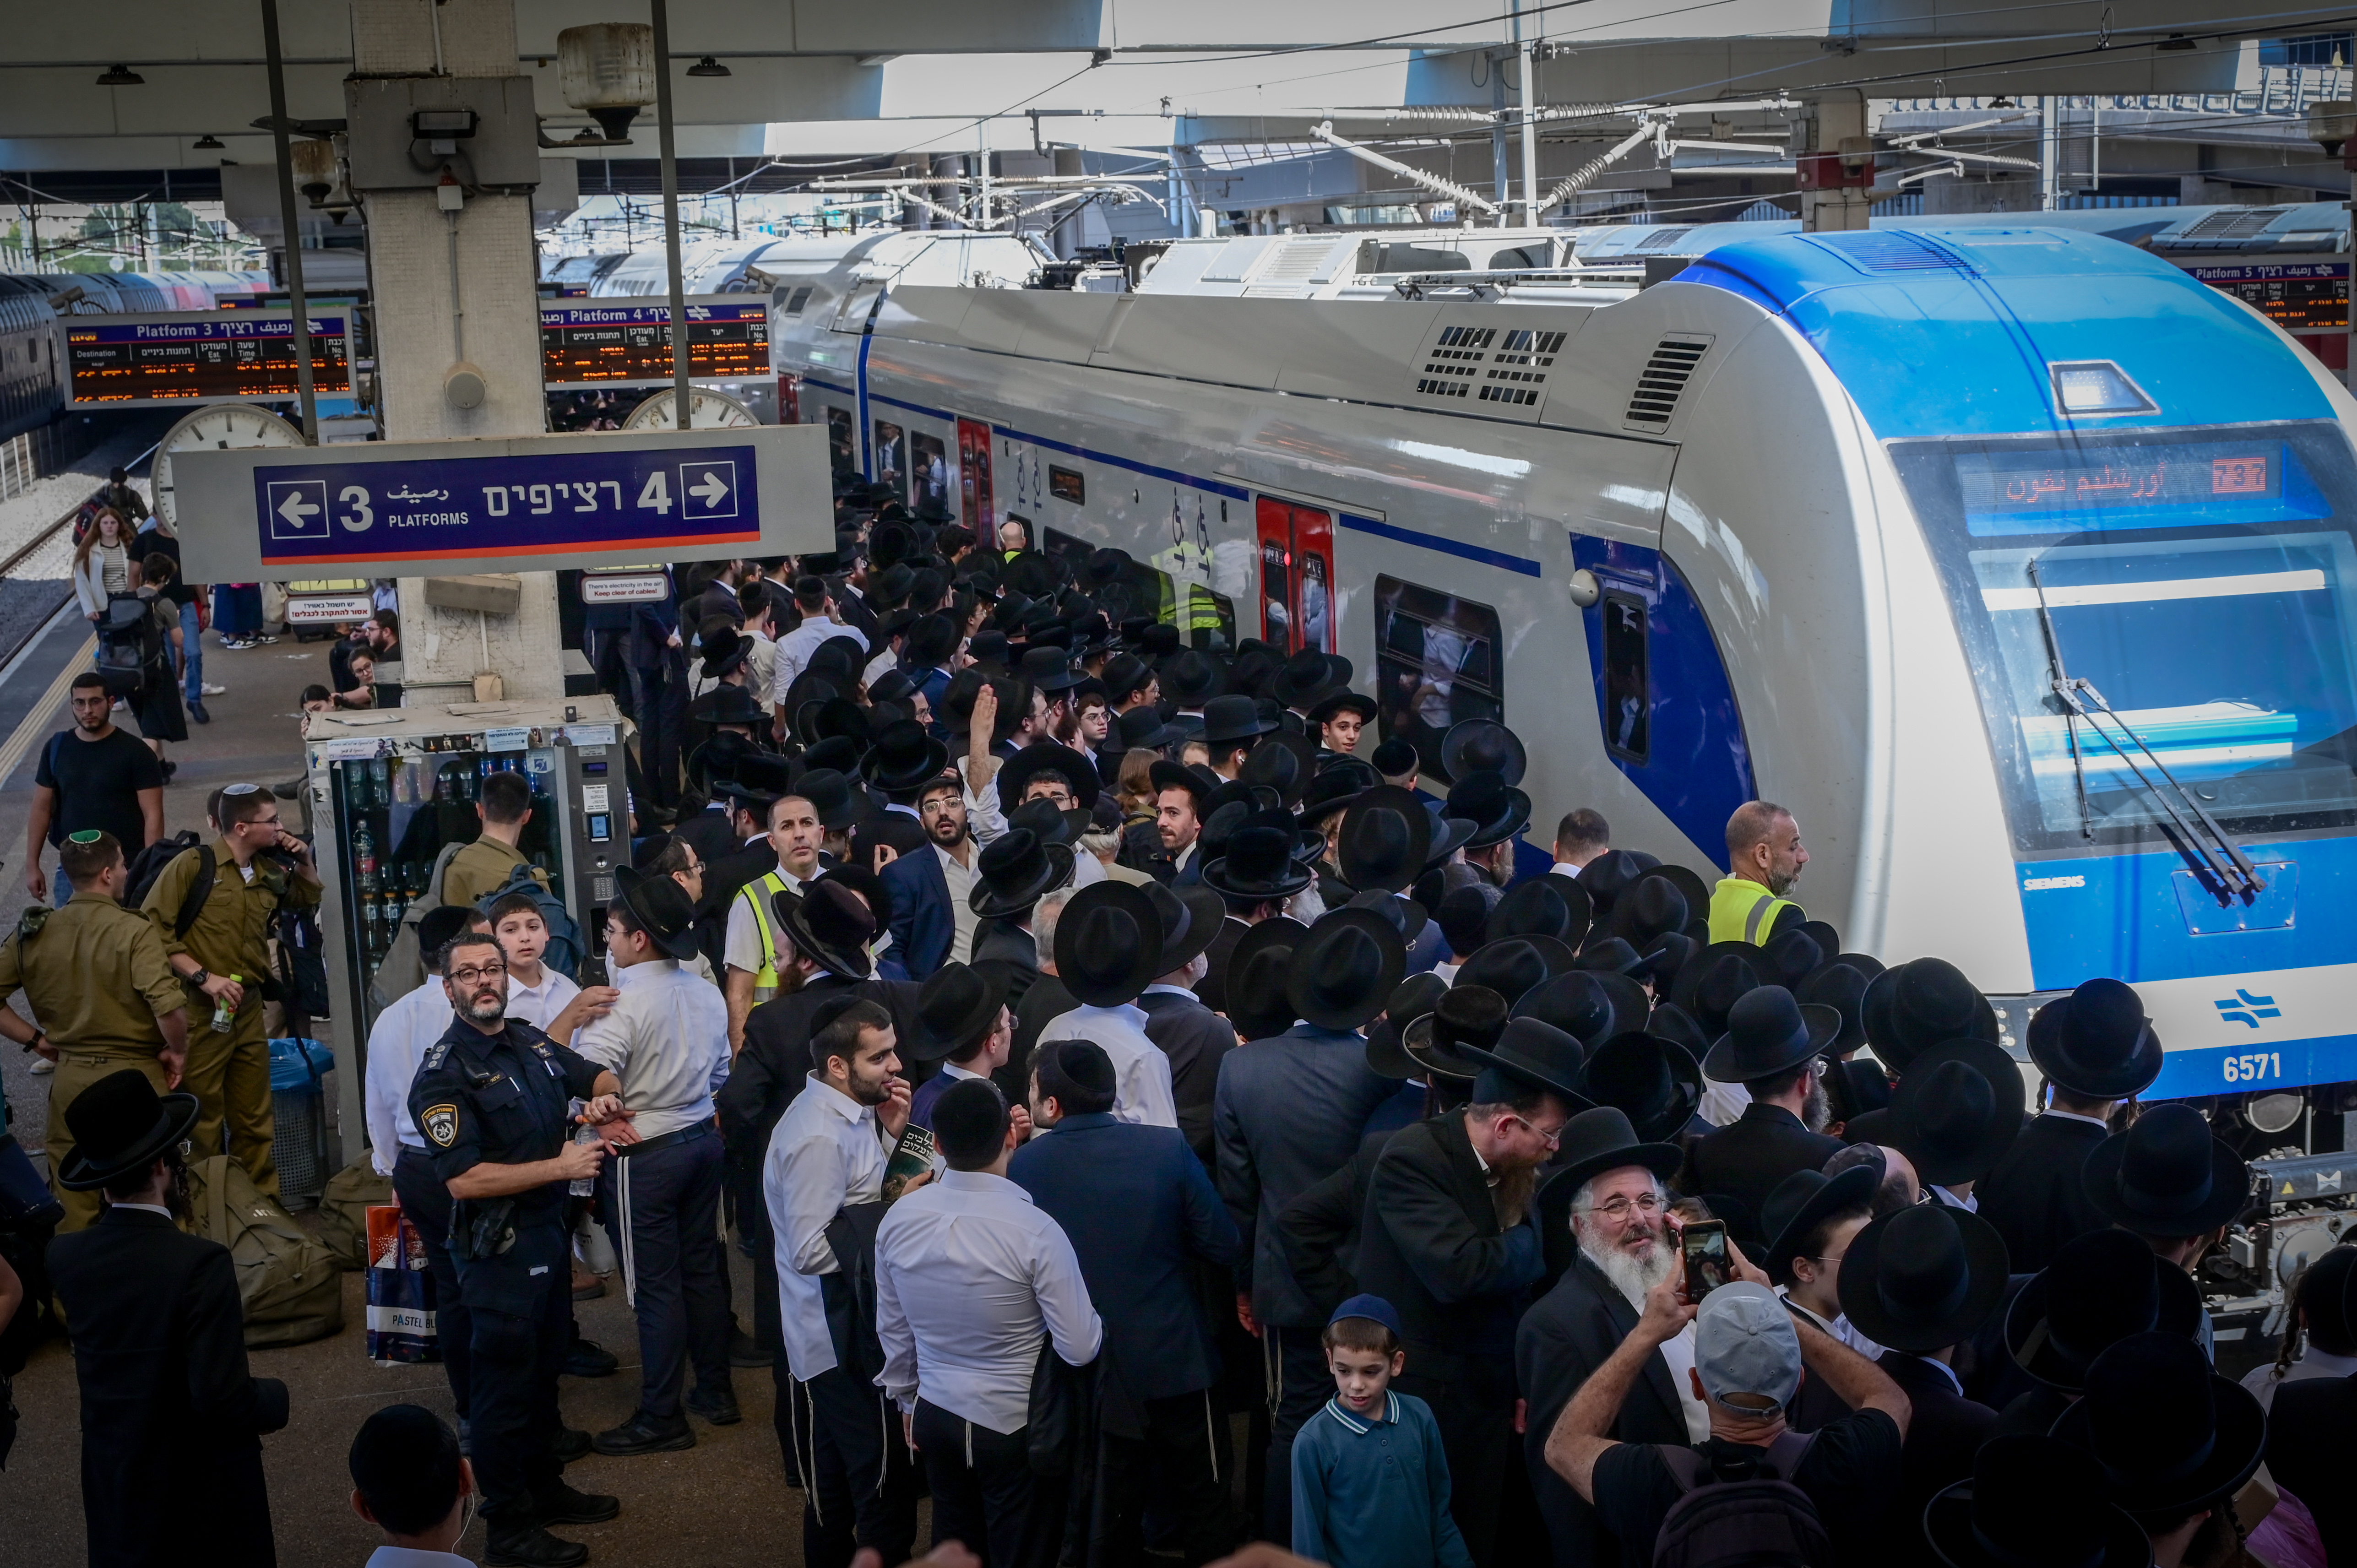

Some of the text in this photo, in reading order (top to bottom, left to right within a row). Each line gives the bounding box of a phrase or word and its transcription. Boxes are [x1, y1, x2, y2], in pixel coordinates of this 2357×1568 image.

[2196, 267, 2252, 278] Platform 5
[2258, 266, 2282, 279] רציף
[2286, 266, 2311, 276] رصيف
[570, 308, 642, 322] Platform 4
[649, 308, 671, 322] ציף
[137, 323, 212, 337] Platform 3
[220, 322, 254, 337] רציף
[260, 321, 292, 333] رصيف
[629, 327, 654, 336] מעודכן
[77, 350, 116, 358] Destination
[201, 342, 227, 352] מעודכן
[2215, 463, 2264, 487] 737
[387, 484, 449, 504] رصيف
[482, 481, 622, 517] רציפים
[637, 472, 672, 515] 4
[338, 485, 374, 532] 3
[389, 512, 469, 527] PLATFORMS
[320, 608, 349, 617] להתקרב
[2024, 875, 2085, 891] SIEMENS
[2223, 1052, 2280, 1082] 6571
[907, 1132, 934, 1150] כלבים
[393, 1314, 435, 1329] PASTEL BL
